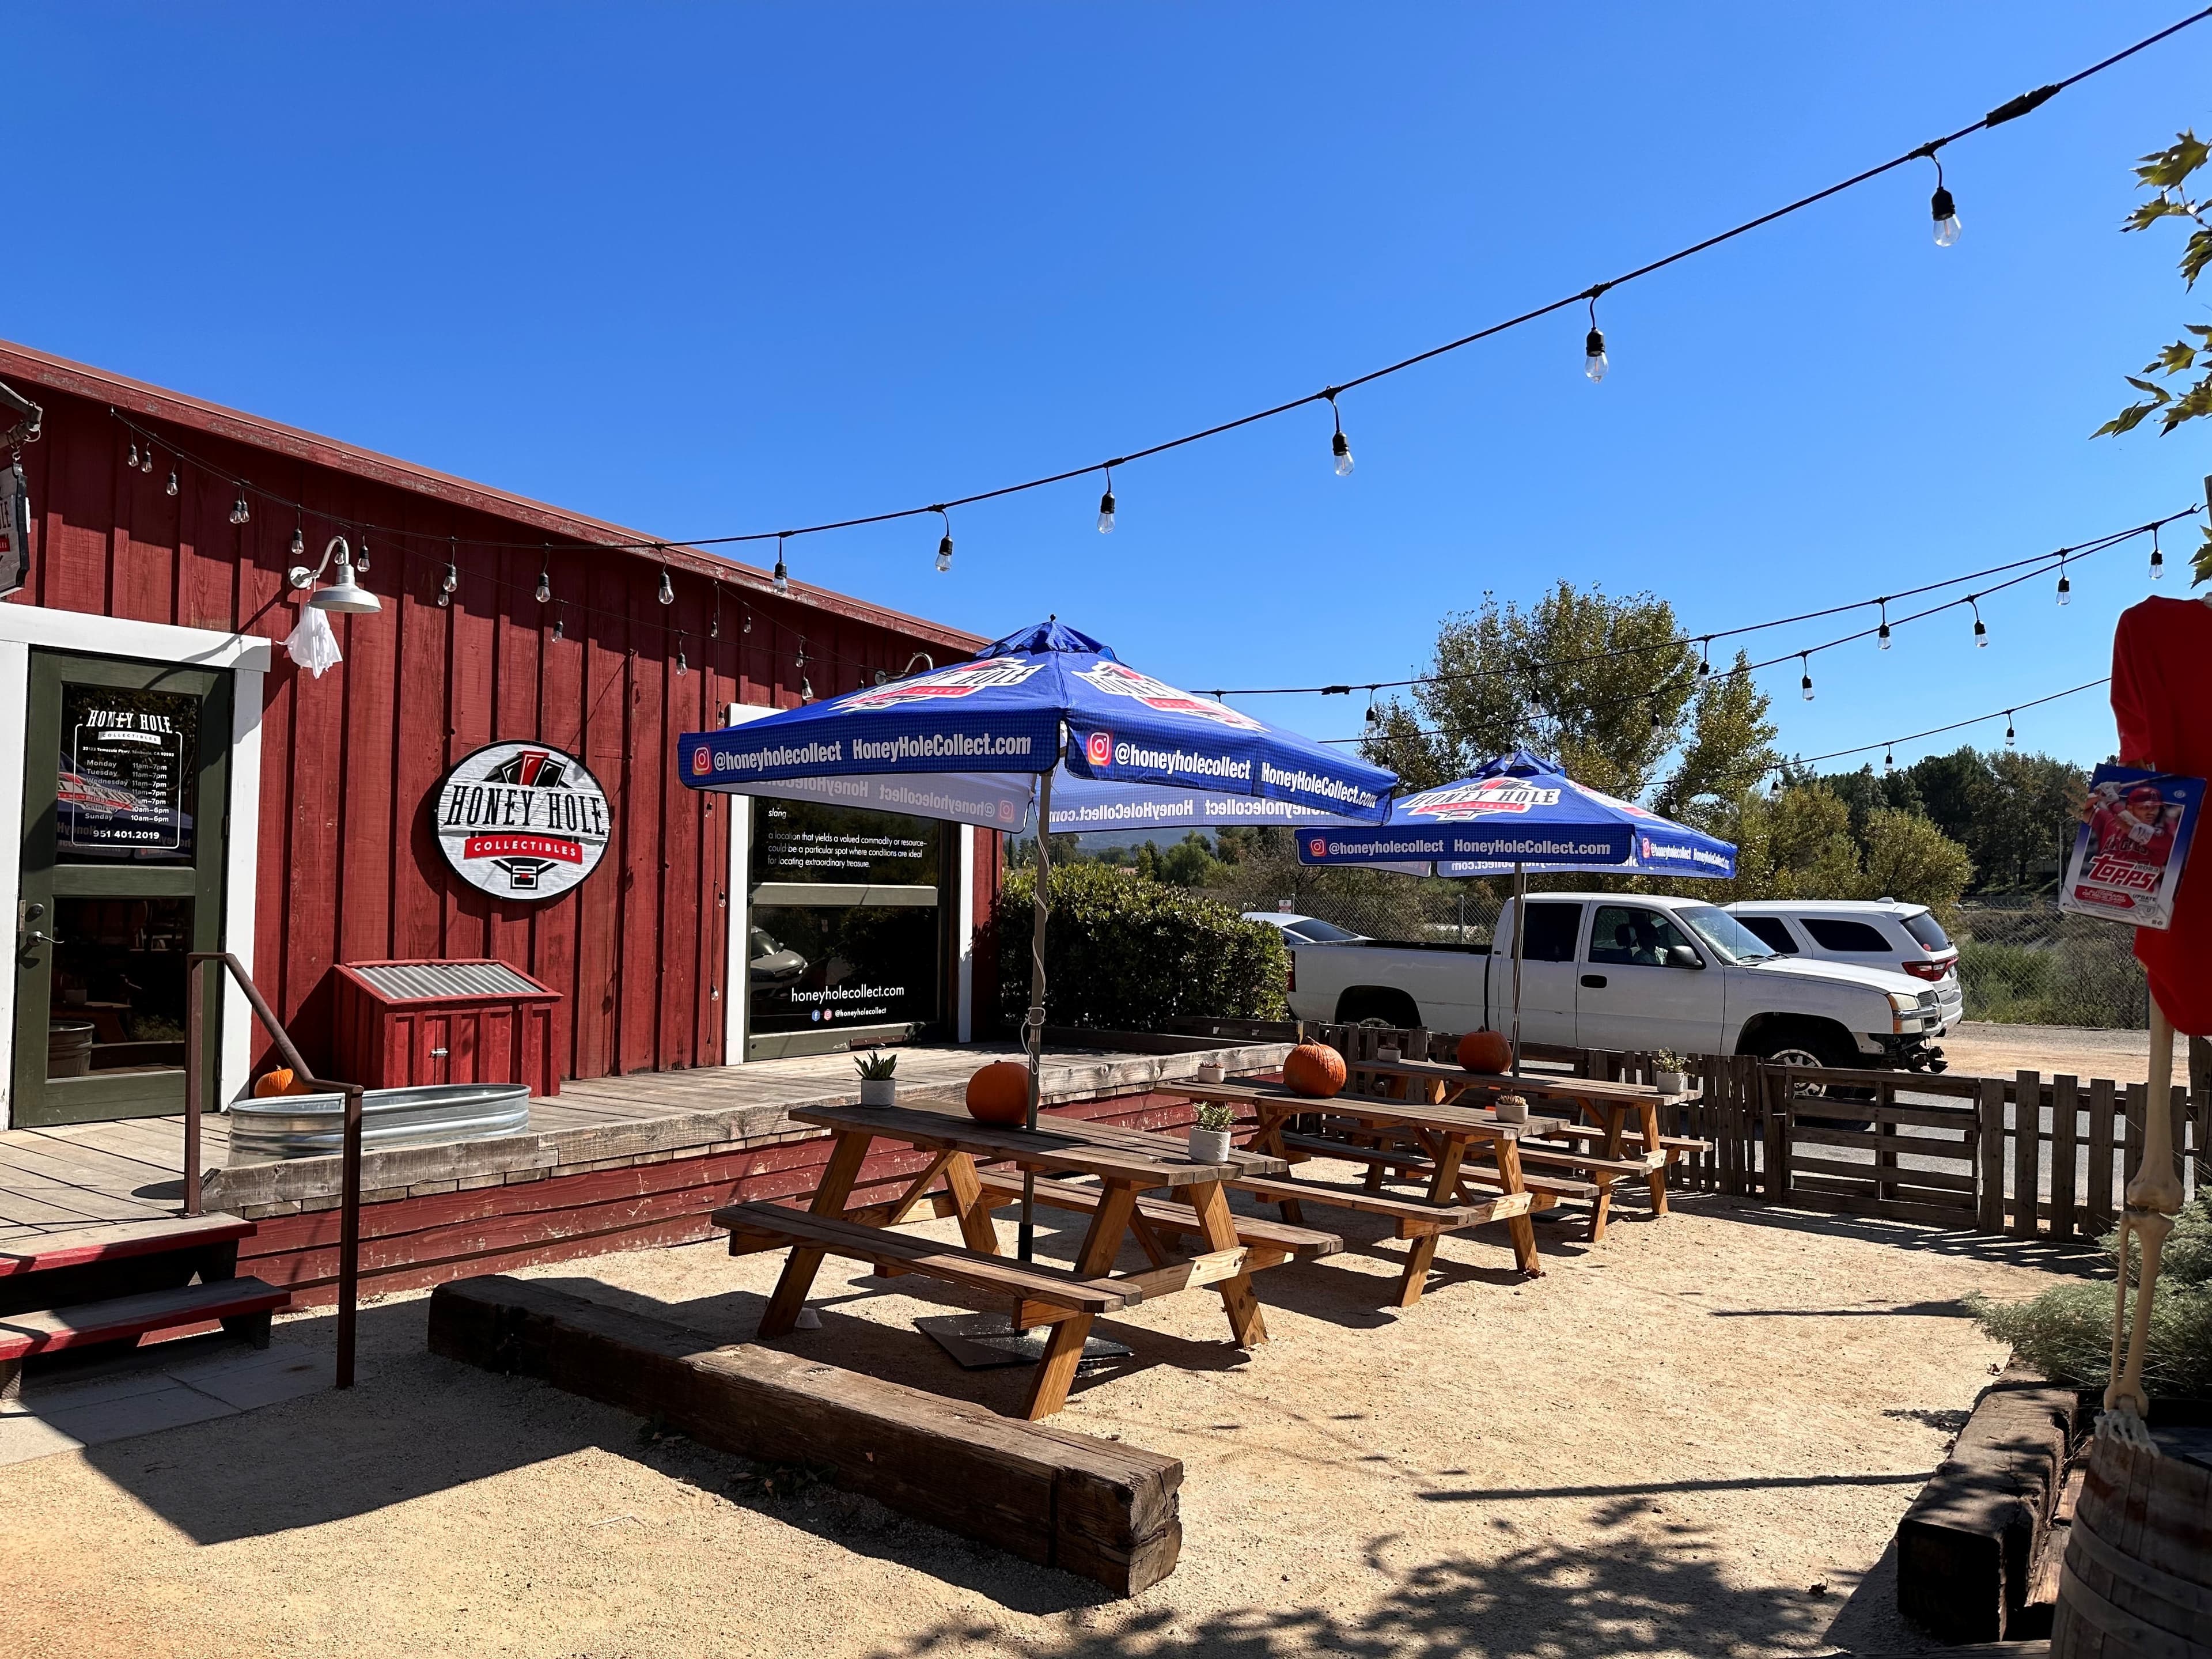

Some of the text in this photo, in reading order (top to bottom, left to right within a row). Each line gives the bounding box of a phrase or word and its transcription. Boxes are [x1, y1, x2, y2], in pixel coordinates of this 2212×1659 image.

[86, 710, 173, 734] HONEY HOLE
[102, 733, 157, 741] COLLECTIBLES
[714, 733, 1031, 772] @honeyholecollect HoneyHoleCollect.com
[86, 759, 117, 768] Monday
[86, 768, 118, 777] Tuesday
[1115, 743, 1378, 809] @honeyholecollect HoneyHoleCollect.com
[86, 777, 128, 786] Wednesday
[1408, 791, 1550, 806] HONEY HOLE
[85, 813, 113, 821] Sunday
[444, 785, 605, 836] HONEY HOLE
[768, 808, 786, 819] slang
[114, 831, 160, 839] 401.2019
[775, 830, 800, 840] location
[802, 831, 813, 840] that
[815, 832, 832, 843] yields
[839, 834, 859, 843] valued
[861, 836, 892, 847] commodity
[474, 840, 576, 857] COLLECTIBLES
[768, 843, 786, 853] could
[788, 843, 797, 853] be
[805, 844, 834, 855] particular
[835, 847, 848, 857] spot
[849, 846, 867, 855] where
[908, 849, 922, 858] ideal
[1329, 839, 1610, 857] @honeyholecollect HoneyHoleCollect.com
[768, 854, 870, 869] for locating extraordinary treasure.
[2133, 894, 2157, 902] UPDATE
[791, 984, 904, 1005] honeyholecollect.com
[835, 1007, 887, 1018] @honeyholecollect
